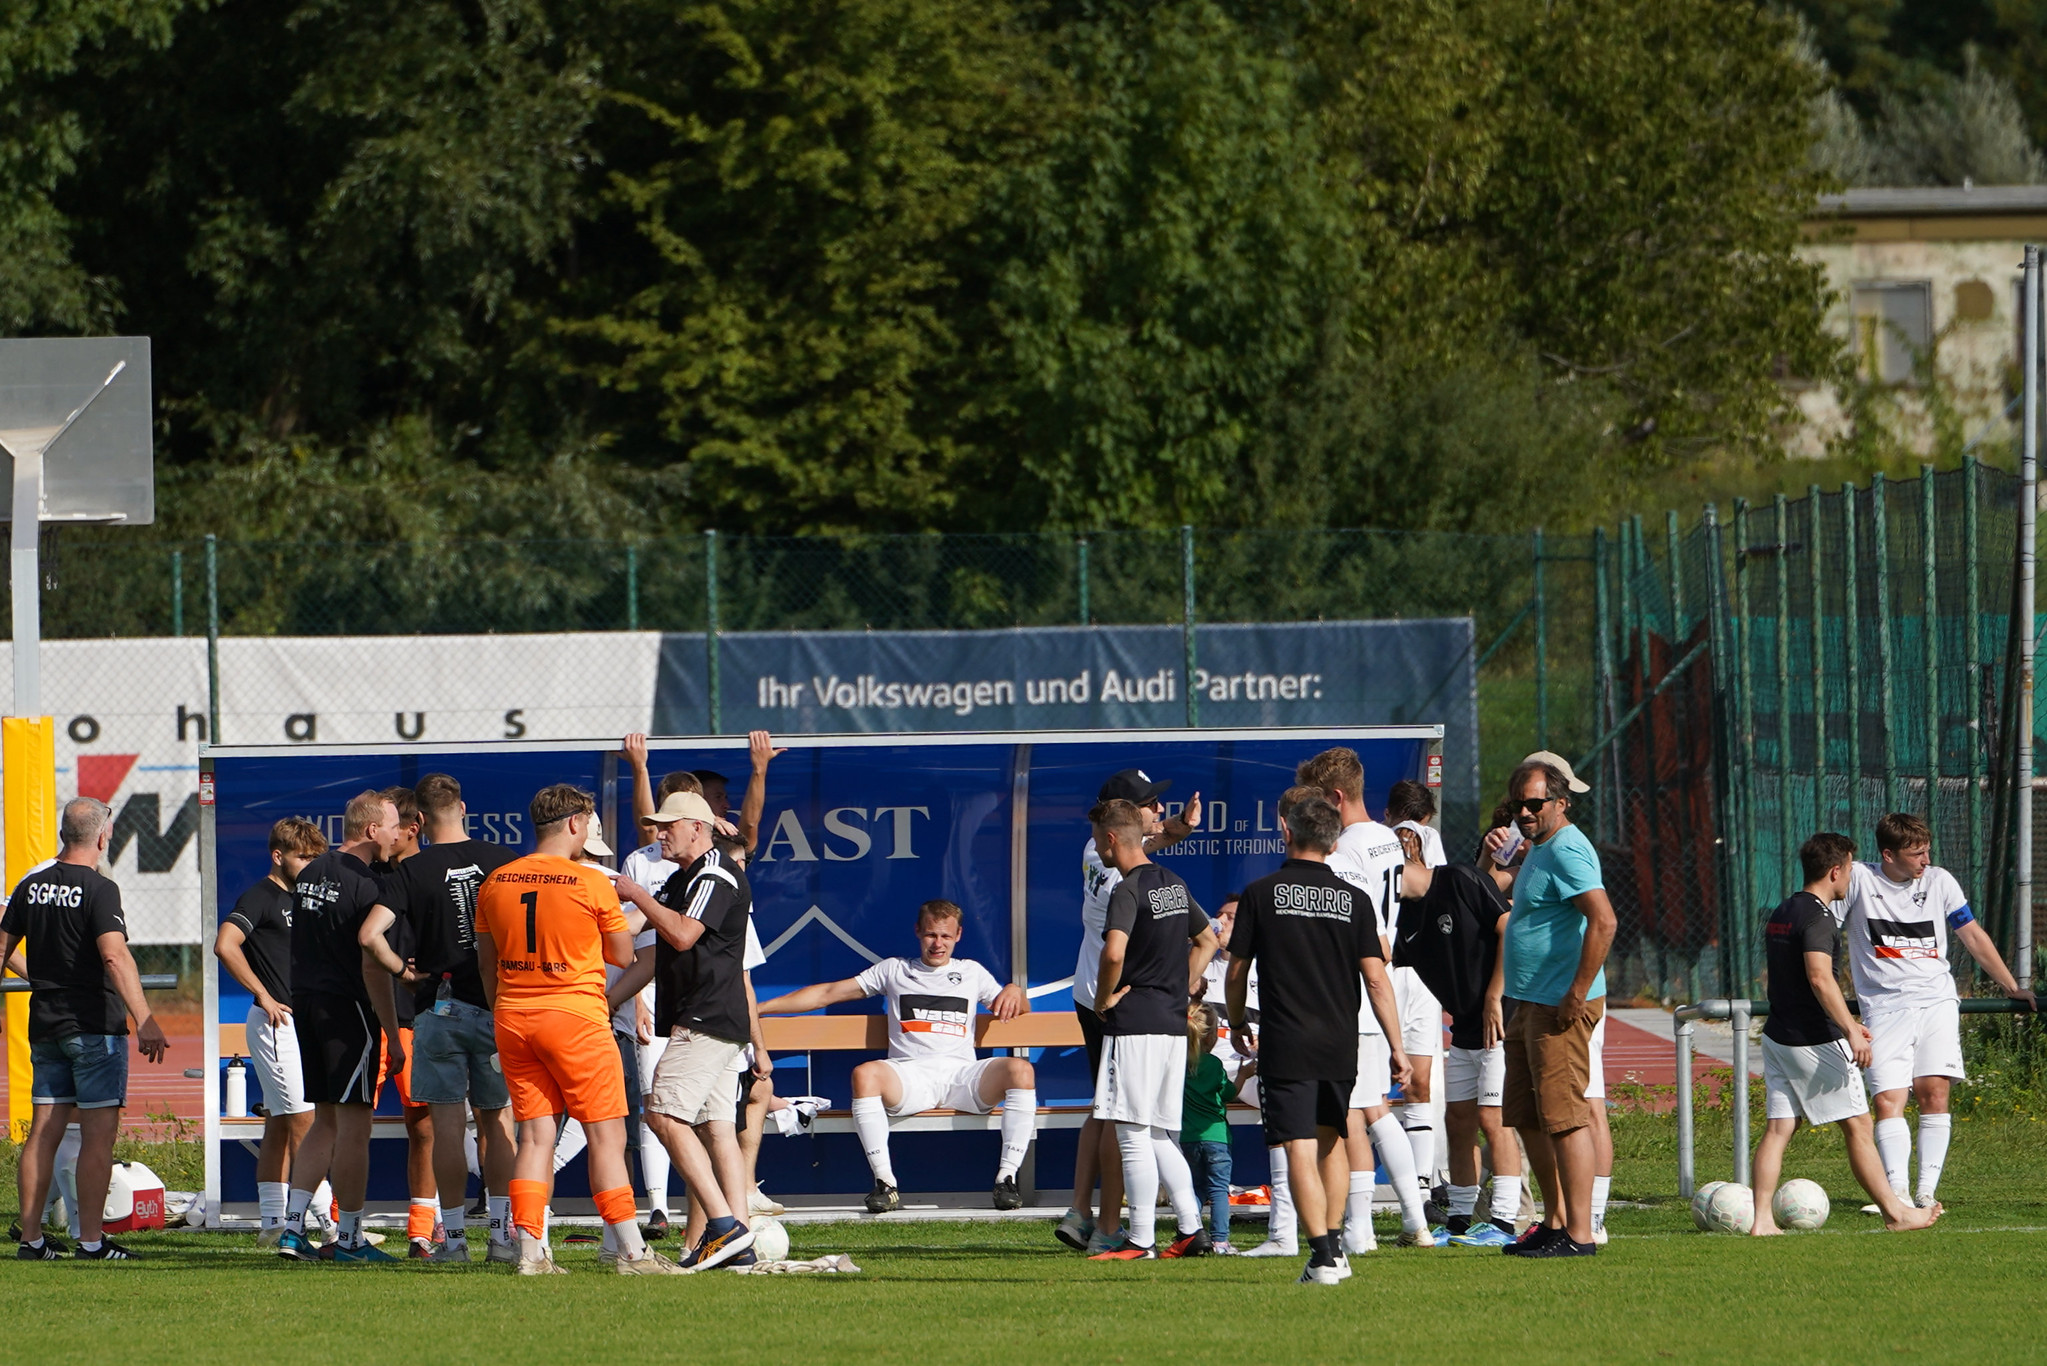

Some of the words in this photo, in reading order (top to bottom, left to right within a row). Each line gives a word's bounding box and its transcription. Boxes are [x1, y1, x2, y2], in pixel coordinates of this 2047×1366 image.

[758, 676, 803, 708] Ihr
[813, 674, 1015, 716] Volkswagen
[1026, 670, 1091, 705] und
[1100, 669, 1176, 703] Audi
[1235, 820, 1249, 832] OF
[1225, 838, 1286, 855] TRADING
[495, 873, 578, 886] REICHERTSHEIM
[1274, 883, 1353, 917] SGRRG
[520, 891, 538, 954] 1
